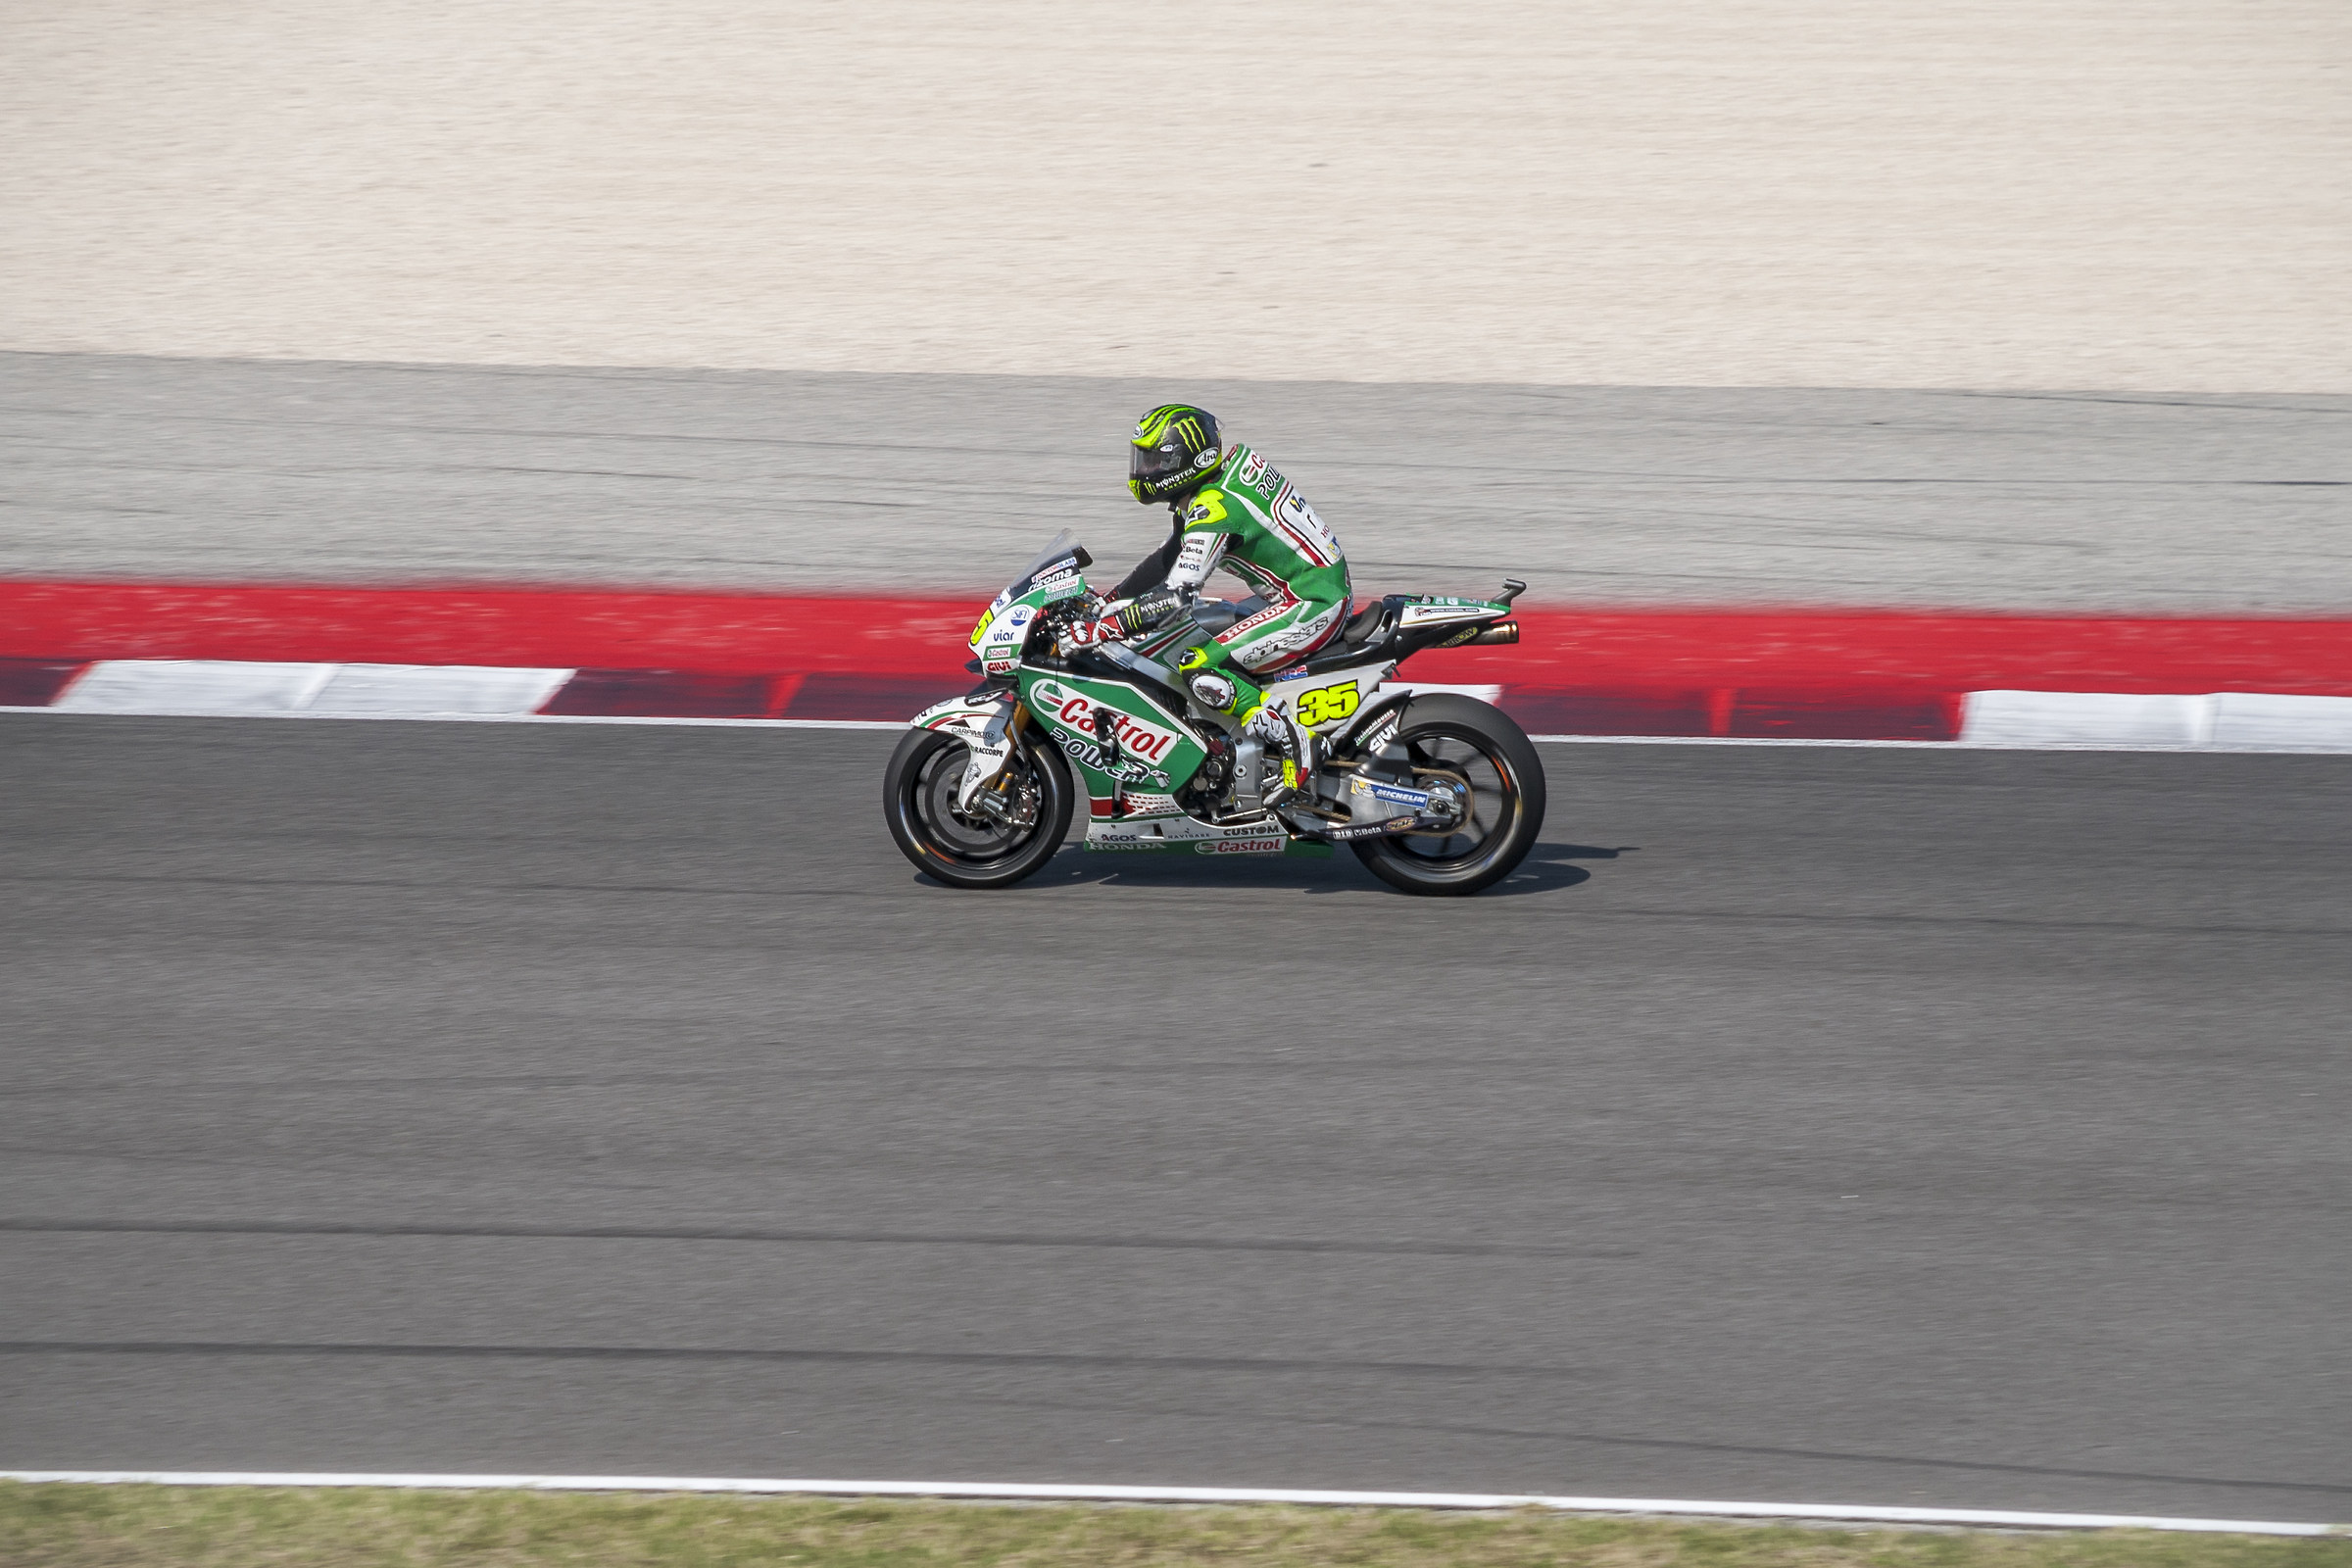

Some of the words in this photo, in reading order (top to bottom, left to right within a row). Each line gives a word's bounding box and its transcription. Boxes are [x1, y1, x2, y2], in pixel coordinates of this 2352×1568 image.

[1155, 466, 1197, 489] MONSTER
[1178, 562, 1201, 572] AGOS
[1226, 603, 1290, 641] HONDA
[987, 662, 1012, 672] GIVI
[1297, 679, 1360, 727] 35
[1376, 789, 1426, 804] MICHELIN
[1102, 833, 1137, 842] AGOS
[1217, 838, 1281, 853] Castrol
